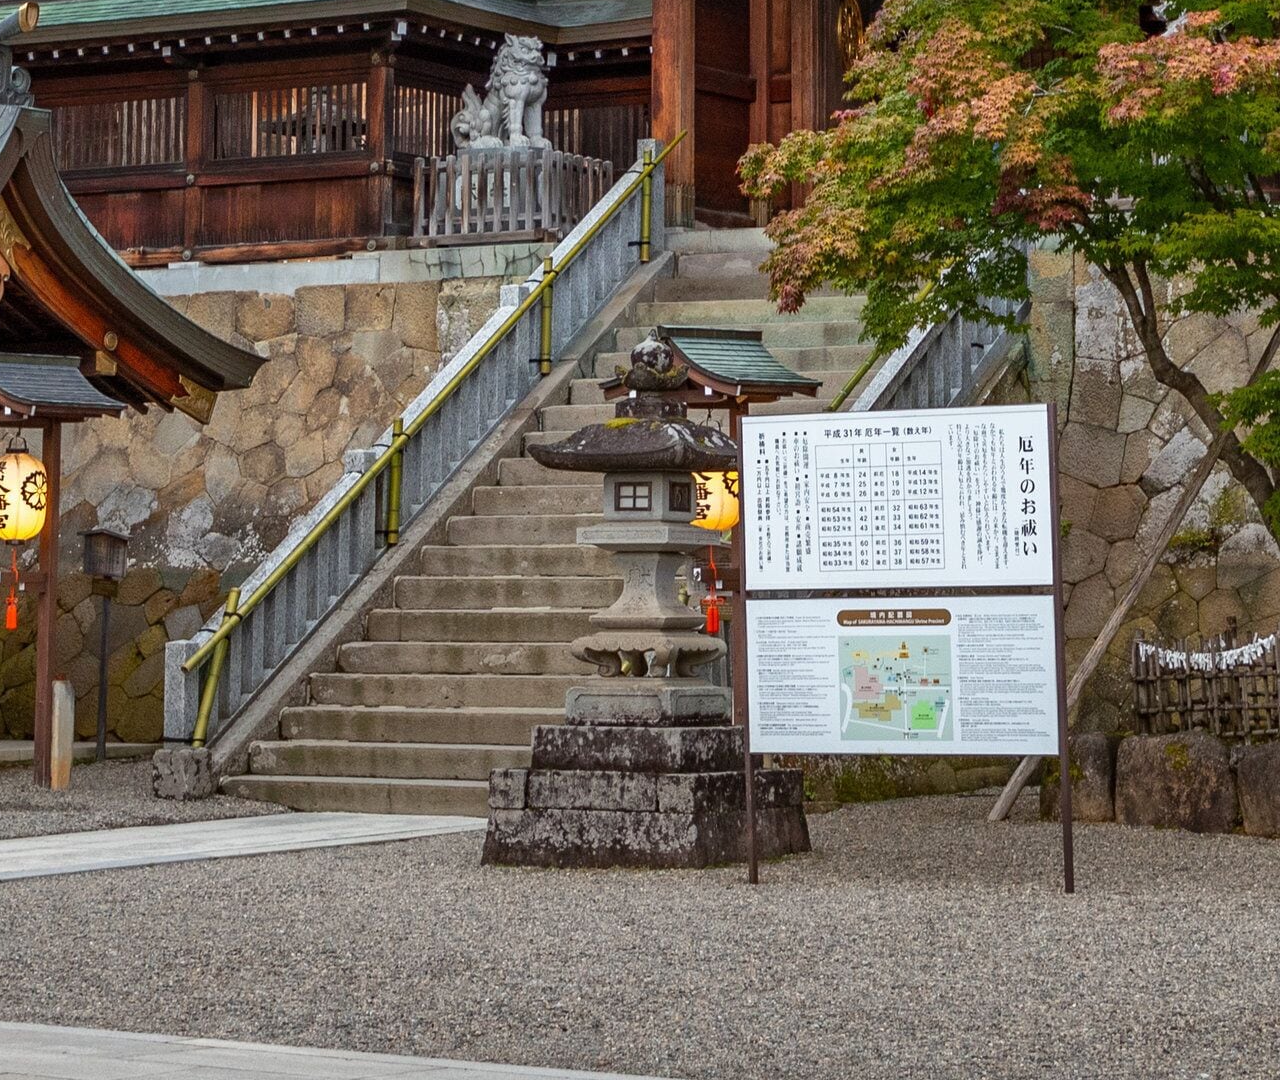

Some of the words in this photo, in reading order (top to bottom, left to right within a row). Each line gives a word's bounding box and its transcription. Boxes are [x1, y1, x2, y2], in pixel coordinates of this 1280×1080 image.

[1019, 435, 1038, 556] 厄年のお祓い
